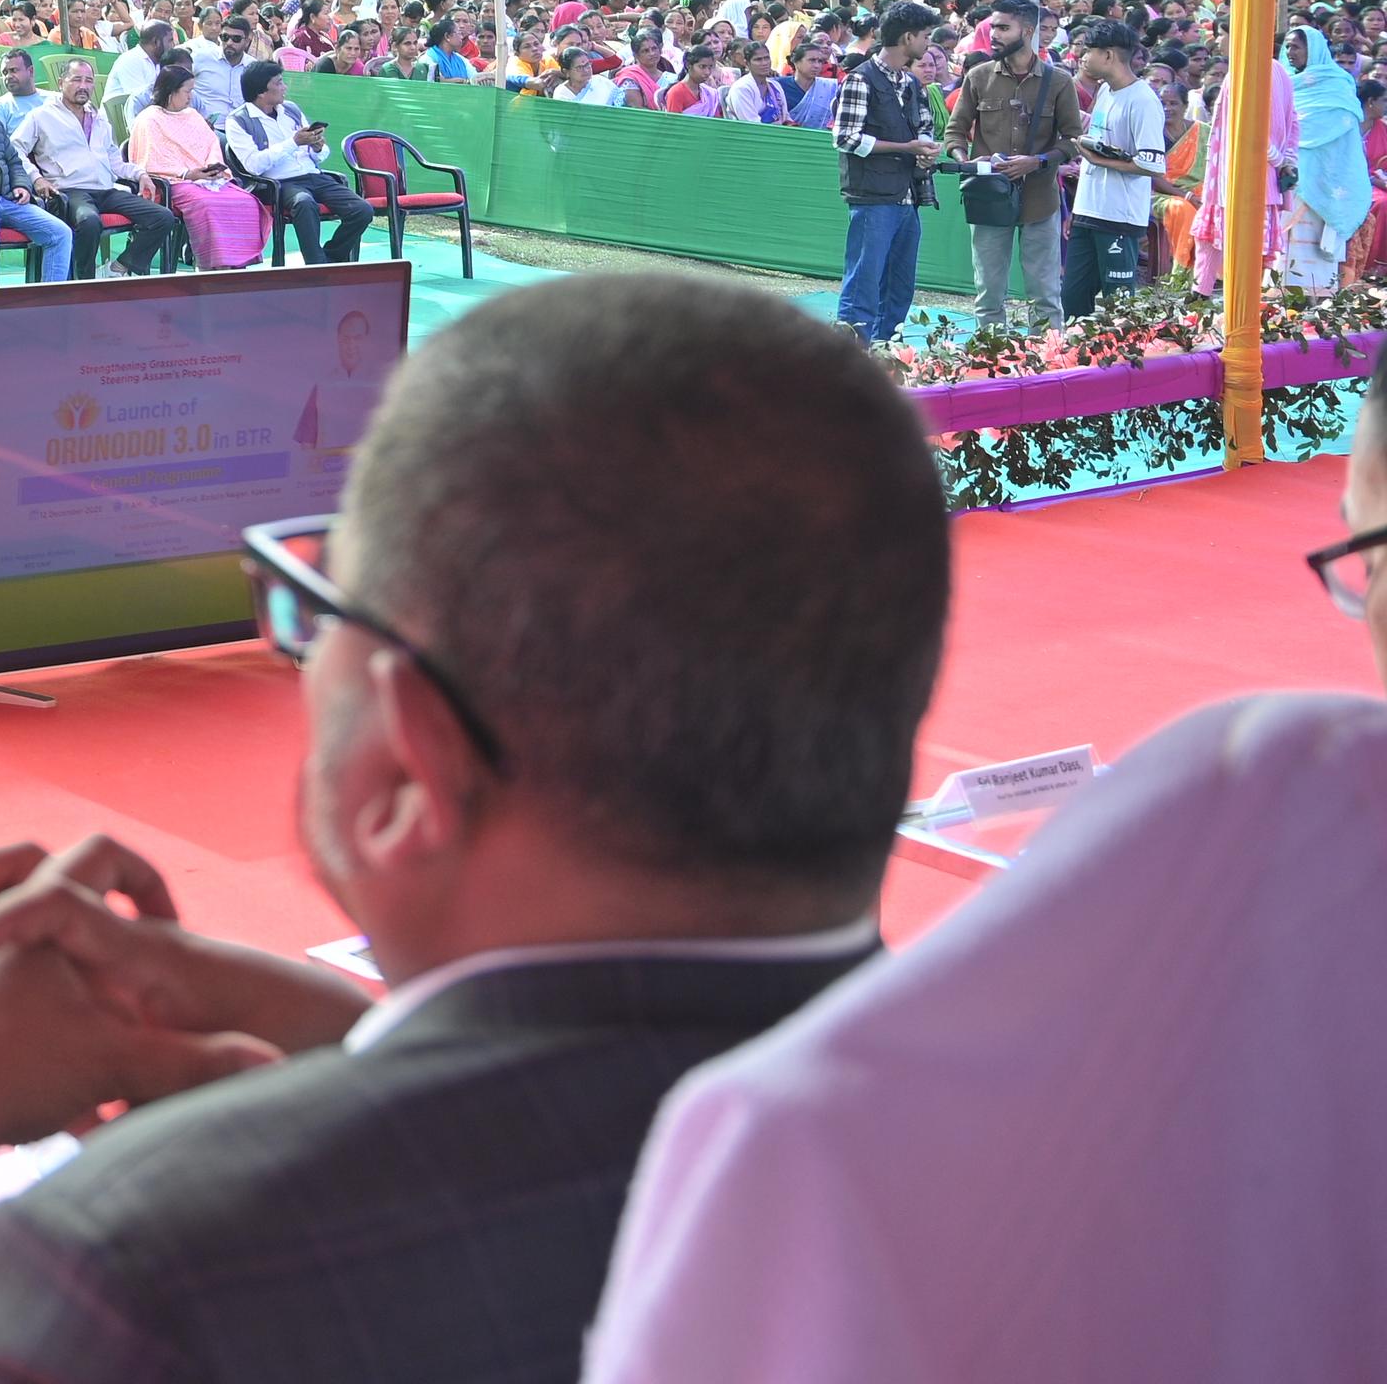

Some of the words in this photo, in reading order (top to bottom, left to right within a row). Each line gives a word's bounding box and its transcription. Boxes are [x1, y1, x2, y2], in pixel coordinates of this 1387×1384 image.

[1108, 271, 1134, 279] JORDAN
[79, 360, 147, 376] Strengthening
[149, 357, 198, 369] Grassroots
[200, 353, 243, 365] Economy
[100, 372, 139, 385] Steering
[142, 369, 180, 381] Assam's
[182, 367, 221, 379] Progress
[106, 400, 172, 423] Launch
[178, 397, 199, 416] of
[45, 427, 166, 467] ORUNODOI
[173, 423, 212, 455] 3.0
[213, 431, 230, 450] in
[235, 427, 273, 448] BTR
[91, 469, 142, 491] Central
[992, 770, 1029, 787] Ranjeet
[1029, 764, 1058, 779] Kumar
[1059, 760, 1084, 774] Dass,
